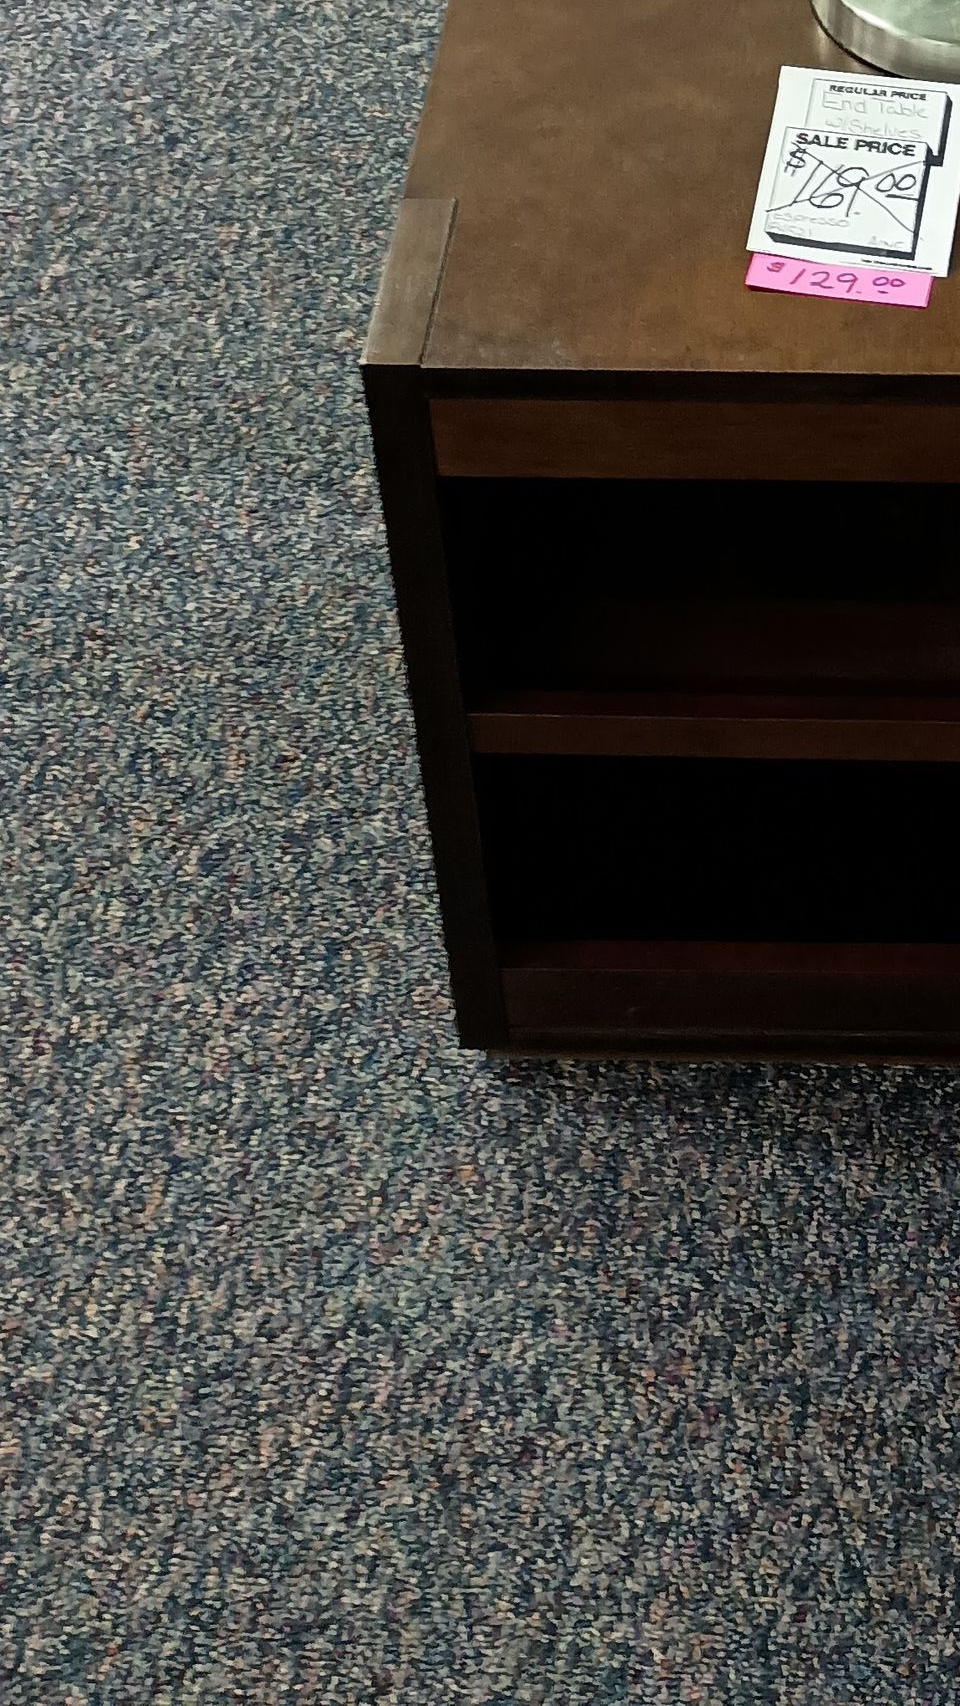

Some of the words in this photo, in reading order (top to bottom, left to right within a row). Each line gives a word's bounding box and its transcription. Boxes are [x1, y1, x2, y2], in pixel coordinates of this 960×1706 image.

[829, 85, 886, 97] REGULAR
[890, 90, 927, 101] PRICE
[823, 92, 866, 114] End
[871, 97, 928, 118] Table
[796, 133, 849, 149] SALE
[854, 139, 916, 156] PRICE
